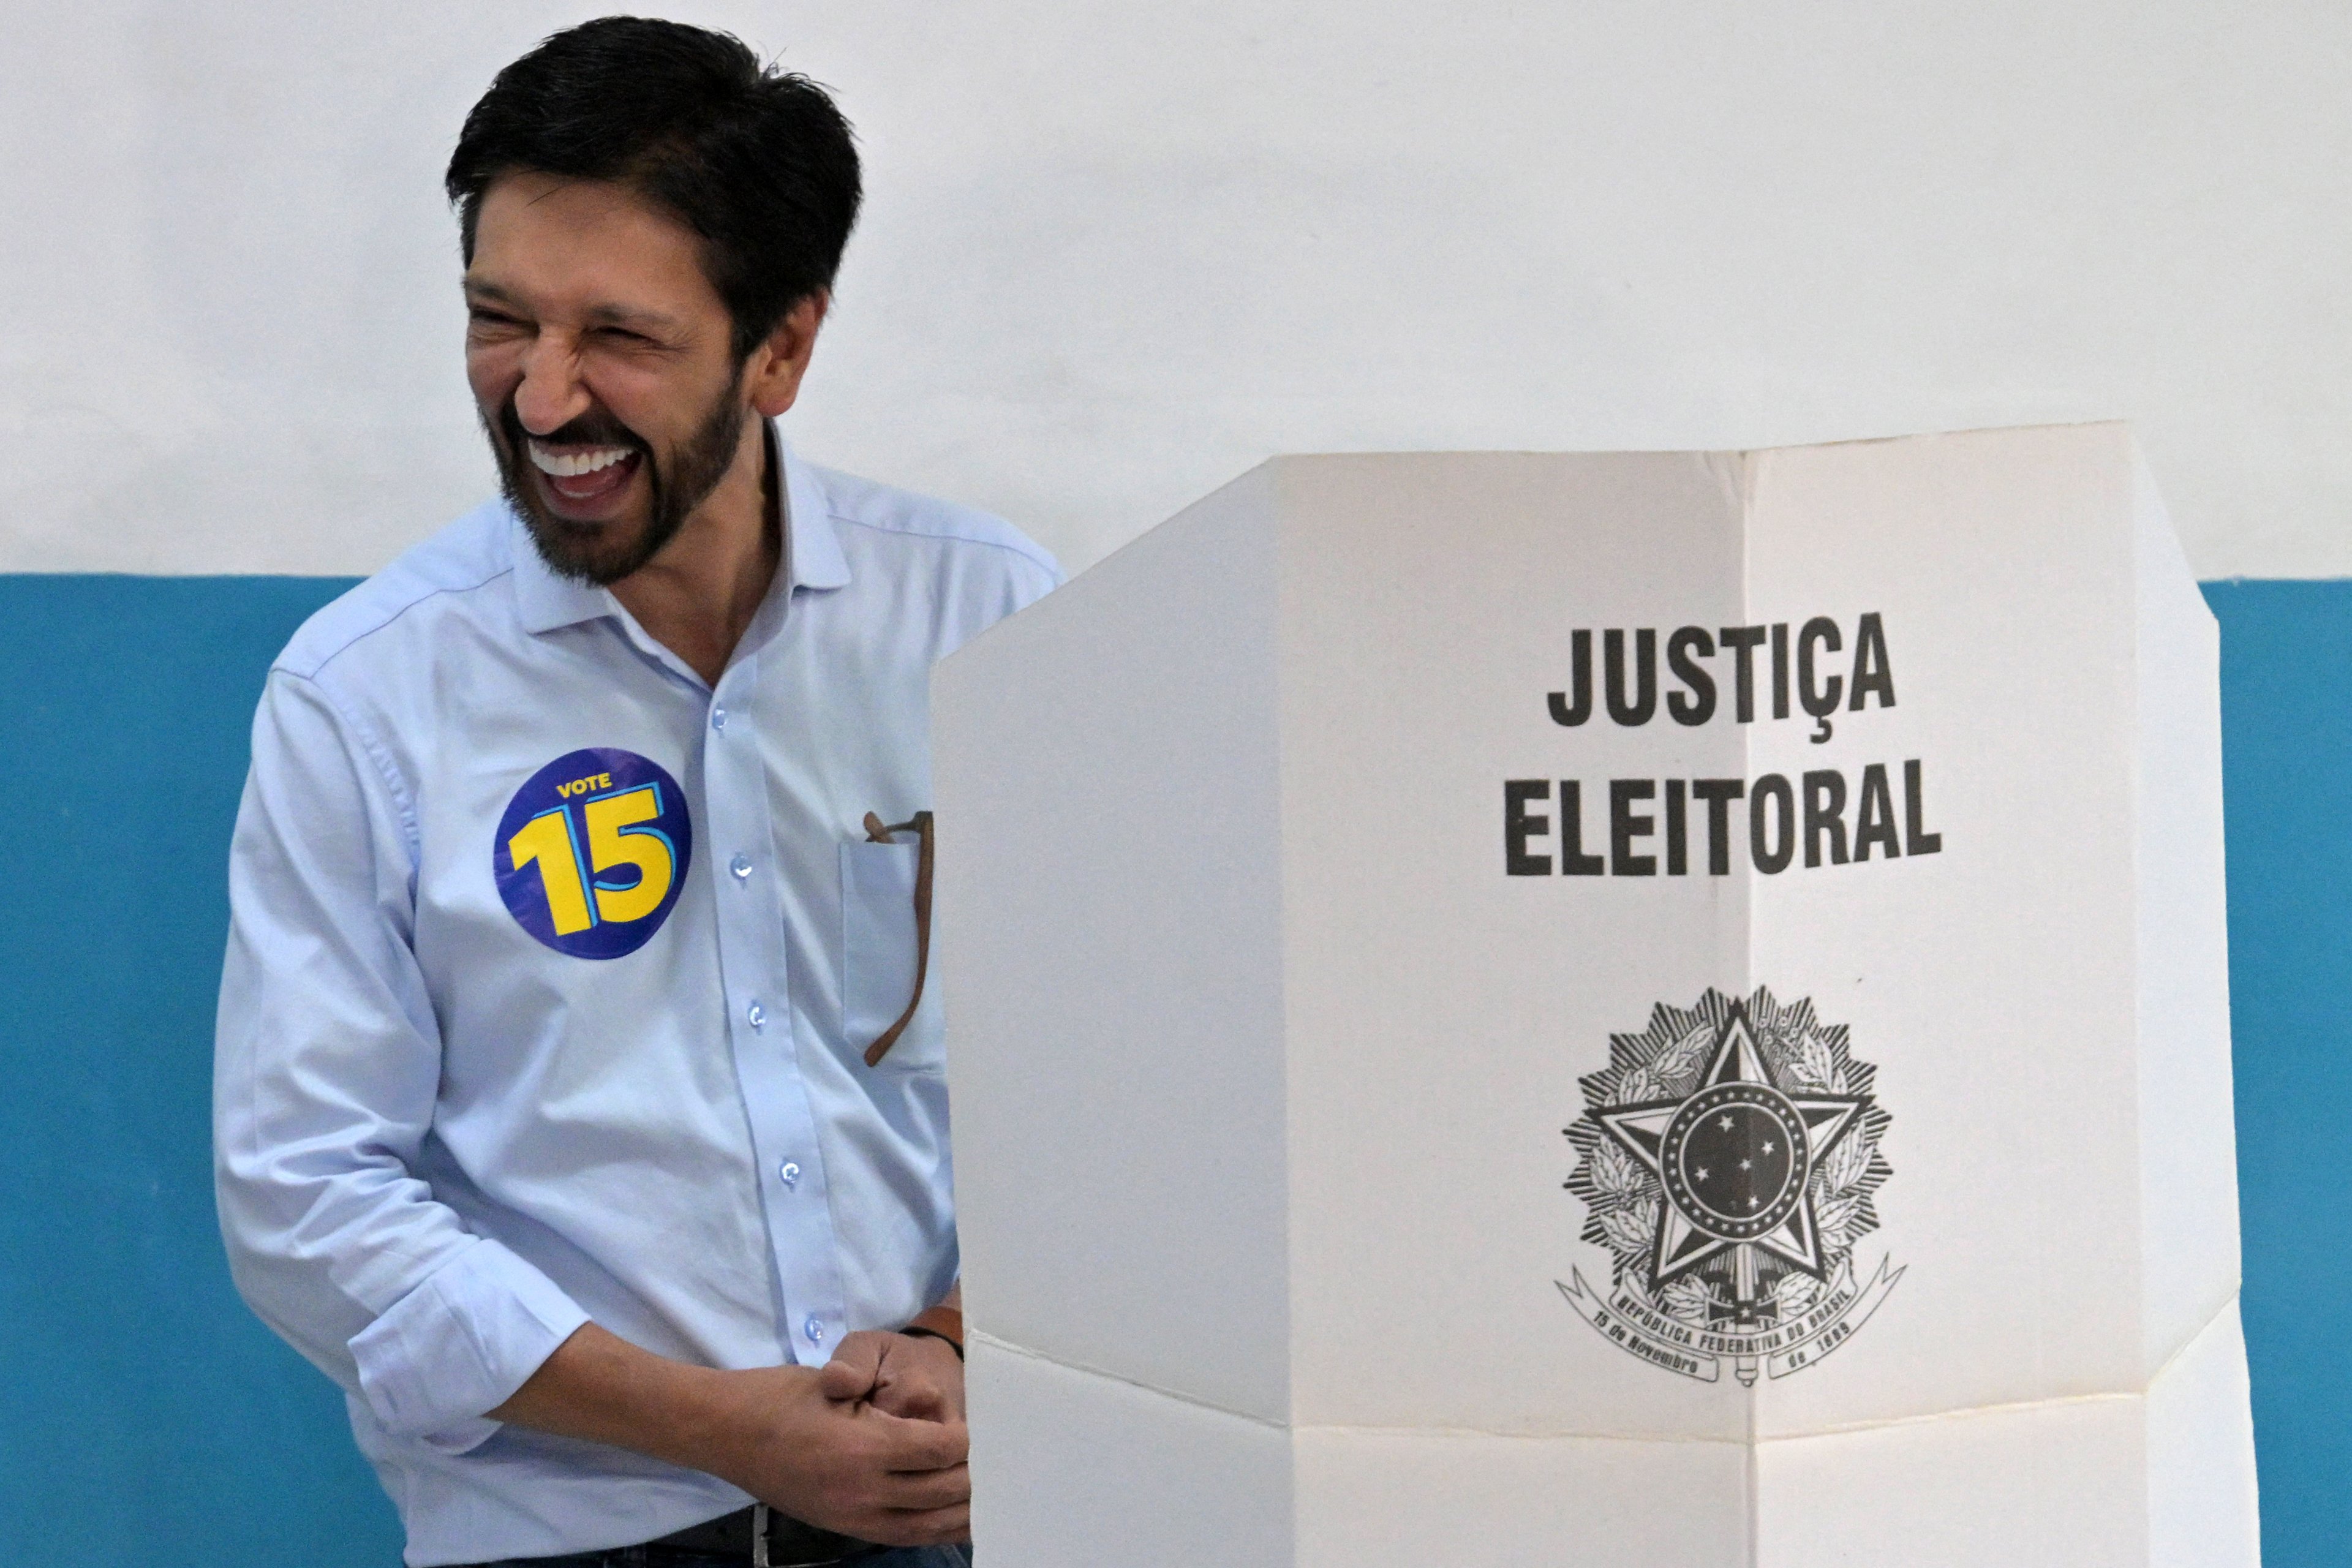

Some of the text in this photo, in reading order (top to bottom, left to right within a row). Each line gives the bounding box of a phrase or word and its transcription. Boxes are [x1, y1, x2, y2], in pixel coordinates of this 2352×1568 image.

[1547, 612, 1896, 744] JUSTIÇA
[556, 772, 612, 799] VOTE
[1504, 759, 1942, 876] ELEITORAL
[508, 782, 677, 937] 15
[1593, 1310, 1610, 1327] 15
[1608, 1324, 1626, 1341] de
[1627, 1335, 1698, 1373] Novembro
[1700, 1333, 1782, 1353] FEDERATIVA
[1787, 1322, 1804, 1341] DO
[1808, 1289, 1850, 1329] BRASIL
